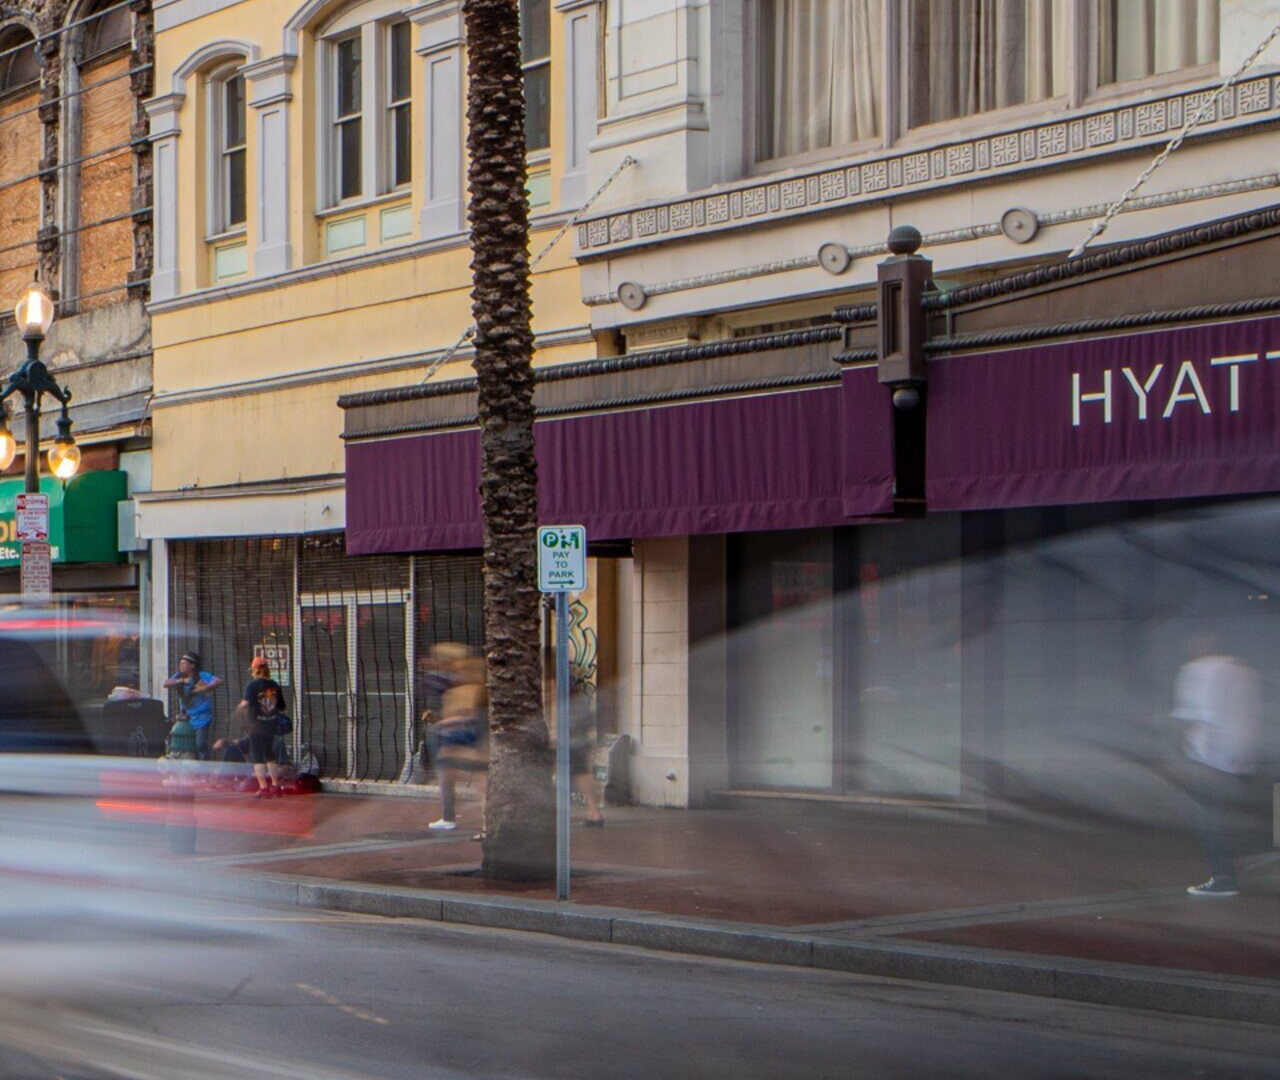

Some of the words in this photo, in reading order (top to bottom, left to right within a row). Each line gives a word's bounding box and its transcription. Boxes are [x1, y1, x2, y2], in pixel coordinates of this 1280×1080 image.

[552, 551, 570, 559] PAY
[555, 561, 569, 569] TO
[548, 570, 575, 578] PARK
[260, 649, 284, 658] FOR
